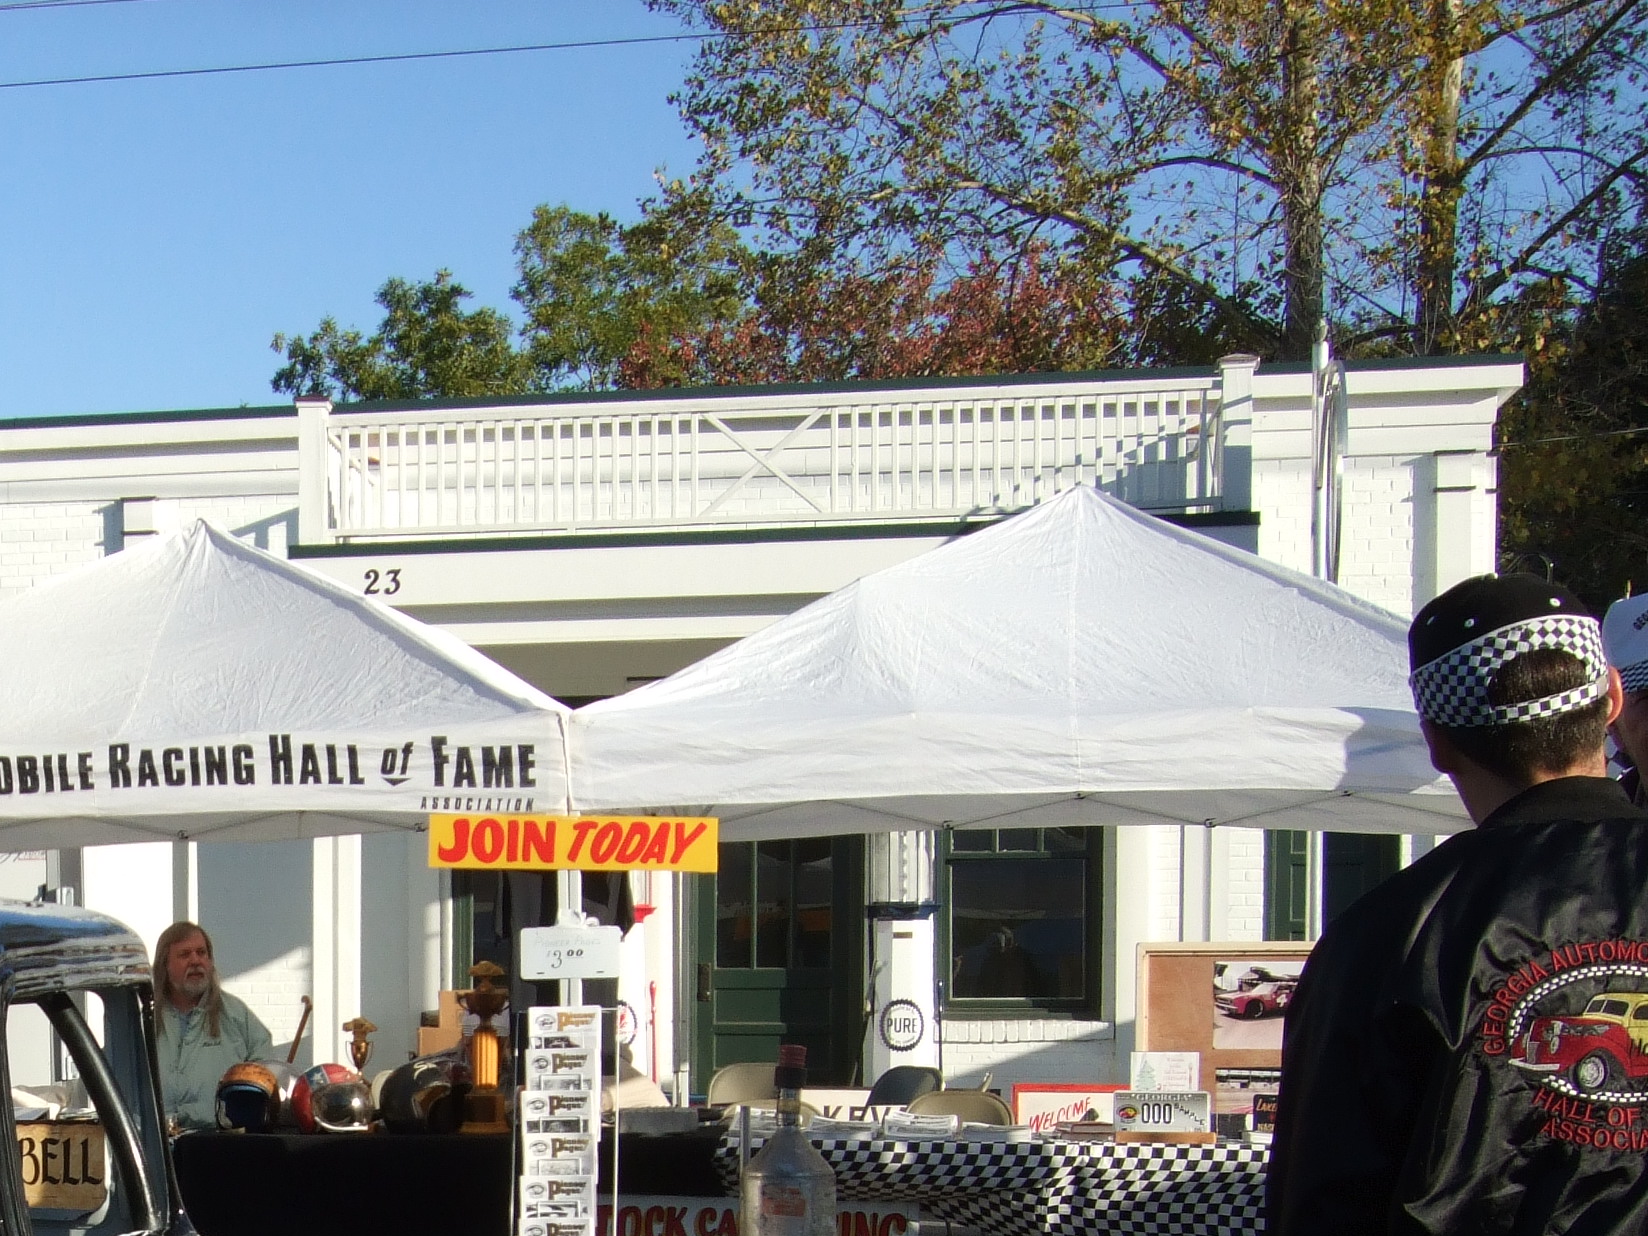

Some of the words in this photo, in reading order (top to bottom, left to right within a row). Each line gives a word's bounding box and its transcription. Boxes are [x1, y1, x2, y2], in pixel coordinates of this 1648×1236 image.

[364, 568, 401, 595] 23
[109, 743, 255, 788] RACING
[269, 734, 365, 785] HALL
[431, 736, 537, 788] FAME
[420, 796, 535, 813] ASSOCIATION
[438, 818, 556, 864] JOIN
[567, 820, 708, 865] TODAY
[886, 1017, 917, 1033] PURE
[1483, 961, 1548, 1056] GEORGIA
[1533, 1088, 1596, 1123] HALL
[1608, 1107, 1640, 1127] OF
